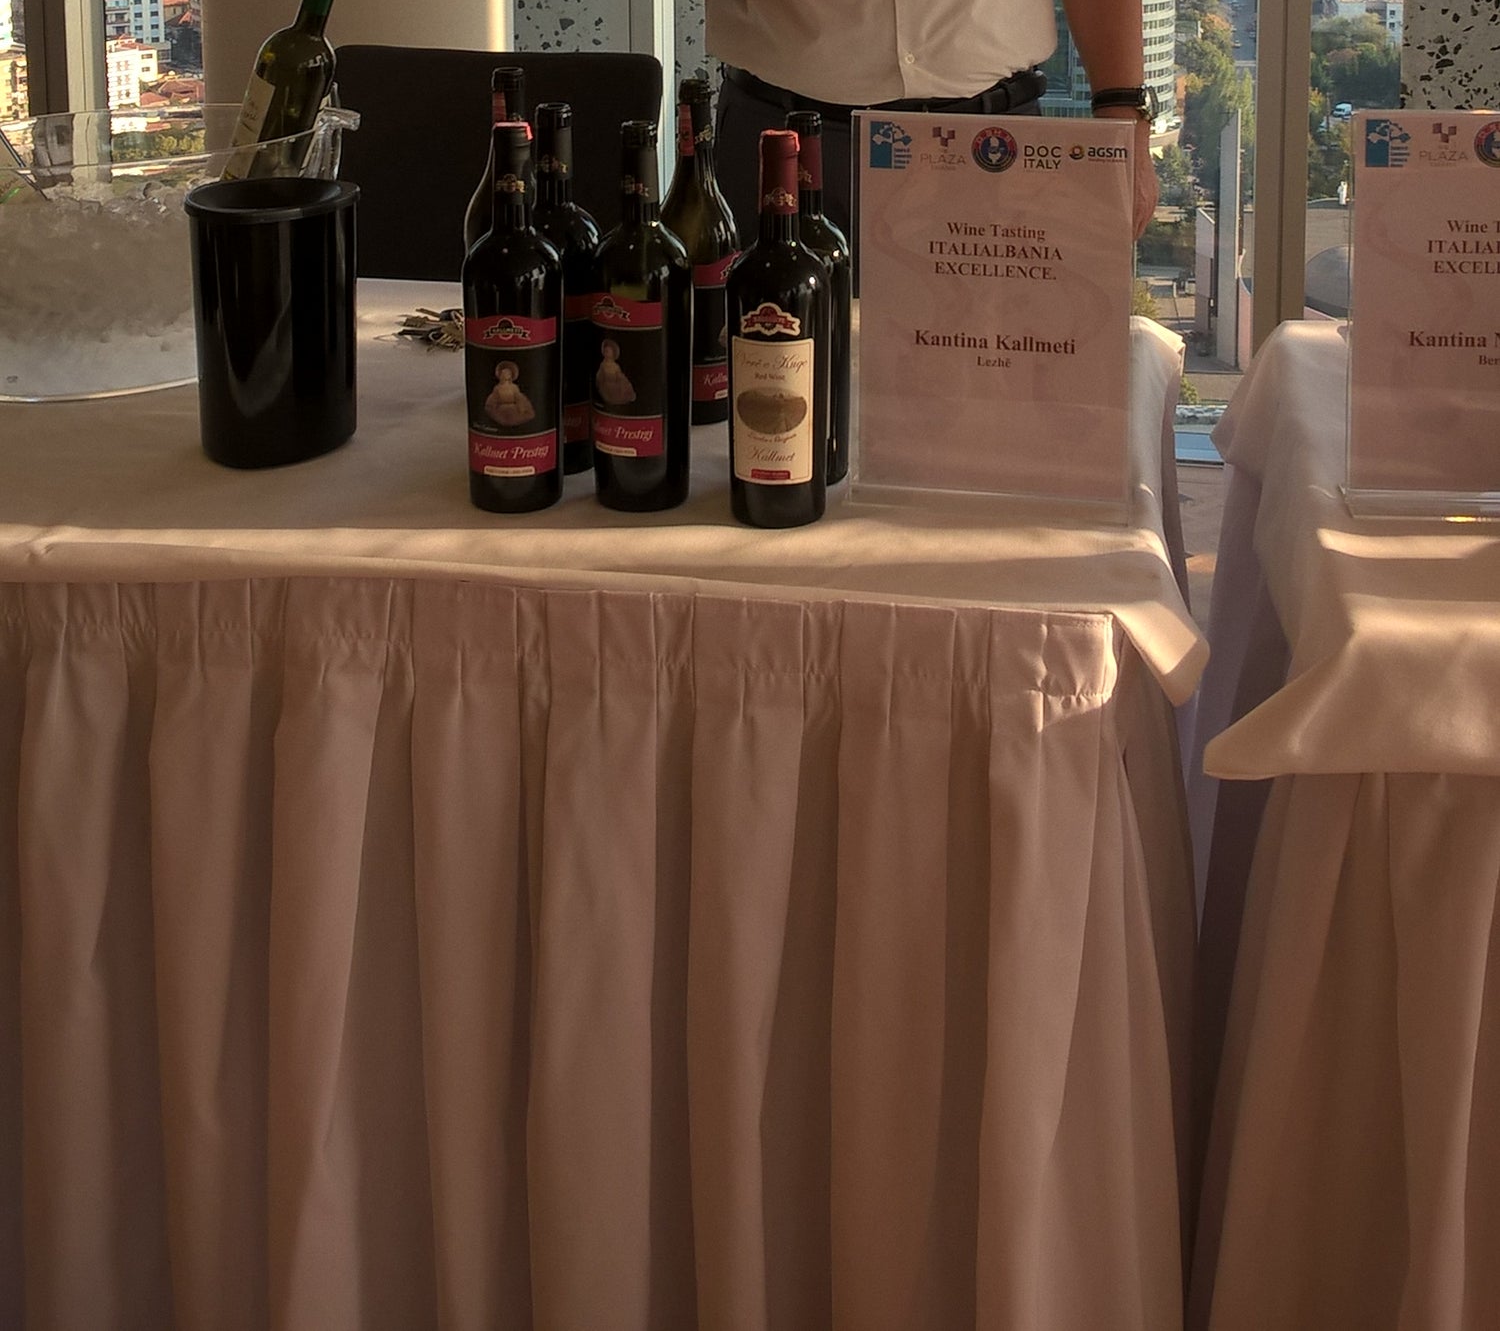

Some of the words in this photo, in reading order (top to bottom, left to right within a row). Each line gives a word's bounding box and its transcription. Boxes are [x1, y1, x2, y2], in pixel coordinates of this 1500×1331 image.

[920, 153, 967, 165] PLAZA
[1024, 145, 1062, 158] DOC
[1419, 150, 1469, 162] PLAZA
[1024, 158, 1062, 170] ITALY
[947, 222, 986, 237] Wine
[990, 224, 1046, 243] Tasting
[1447, 220, 1488, 233] Wine
[929, 240, 1063, 261] ITALIALBANIA
[1427, 240, 1500, 255] ITALIA
[935, 261, 1057, 281] EXCELLENCE.
[914, 329, 988, 350] Kantina
[996, 334, 1076, 355] Kallmeti
[1409, 331, 1487, 348] Kantina
[748, 445, 796, 463] Kallmet
